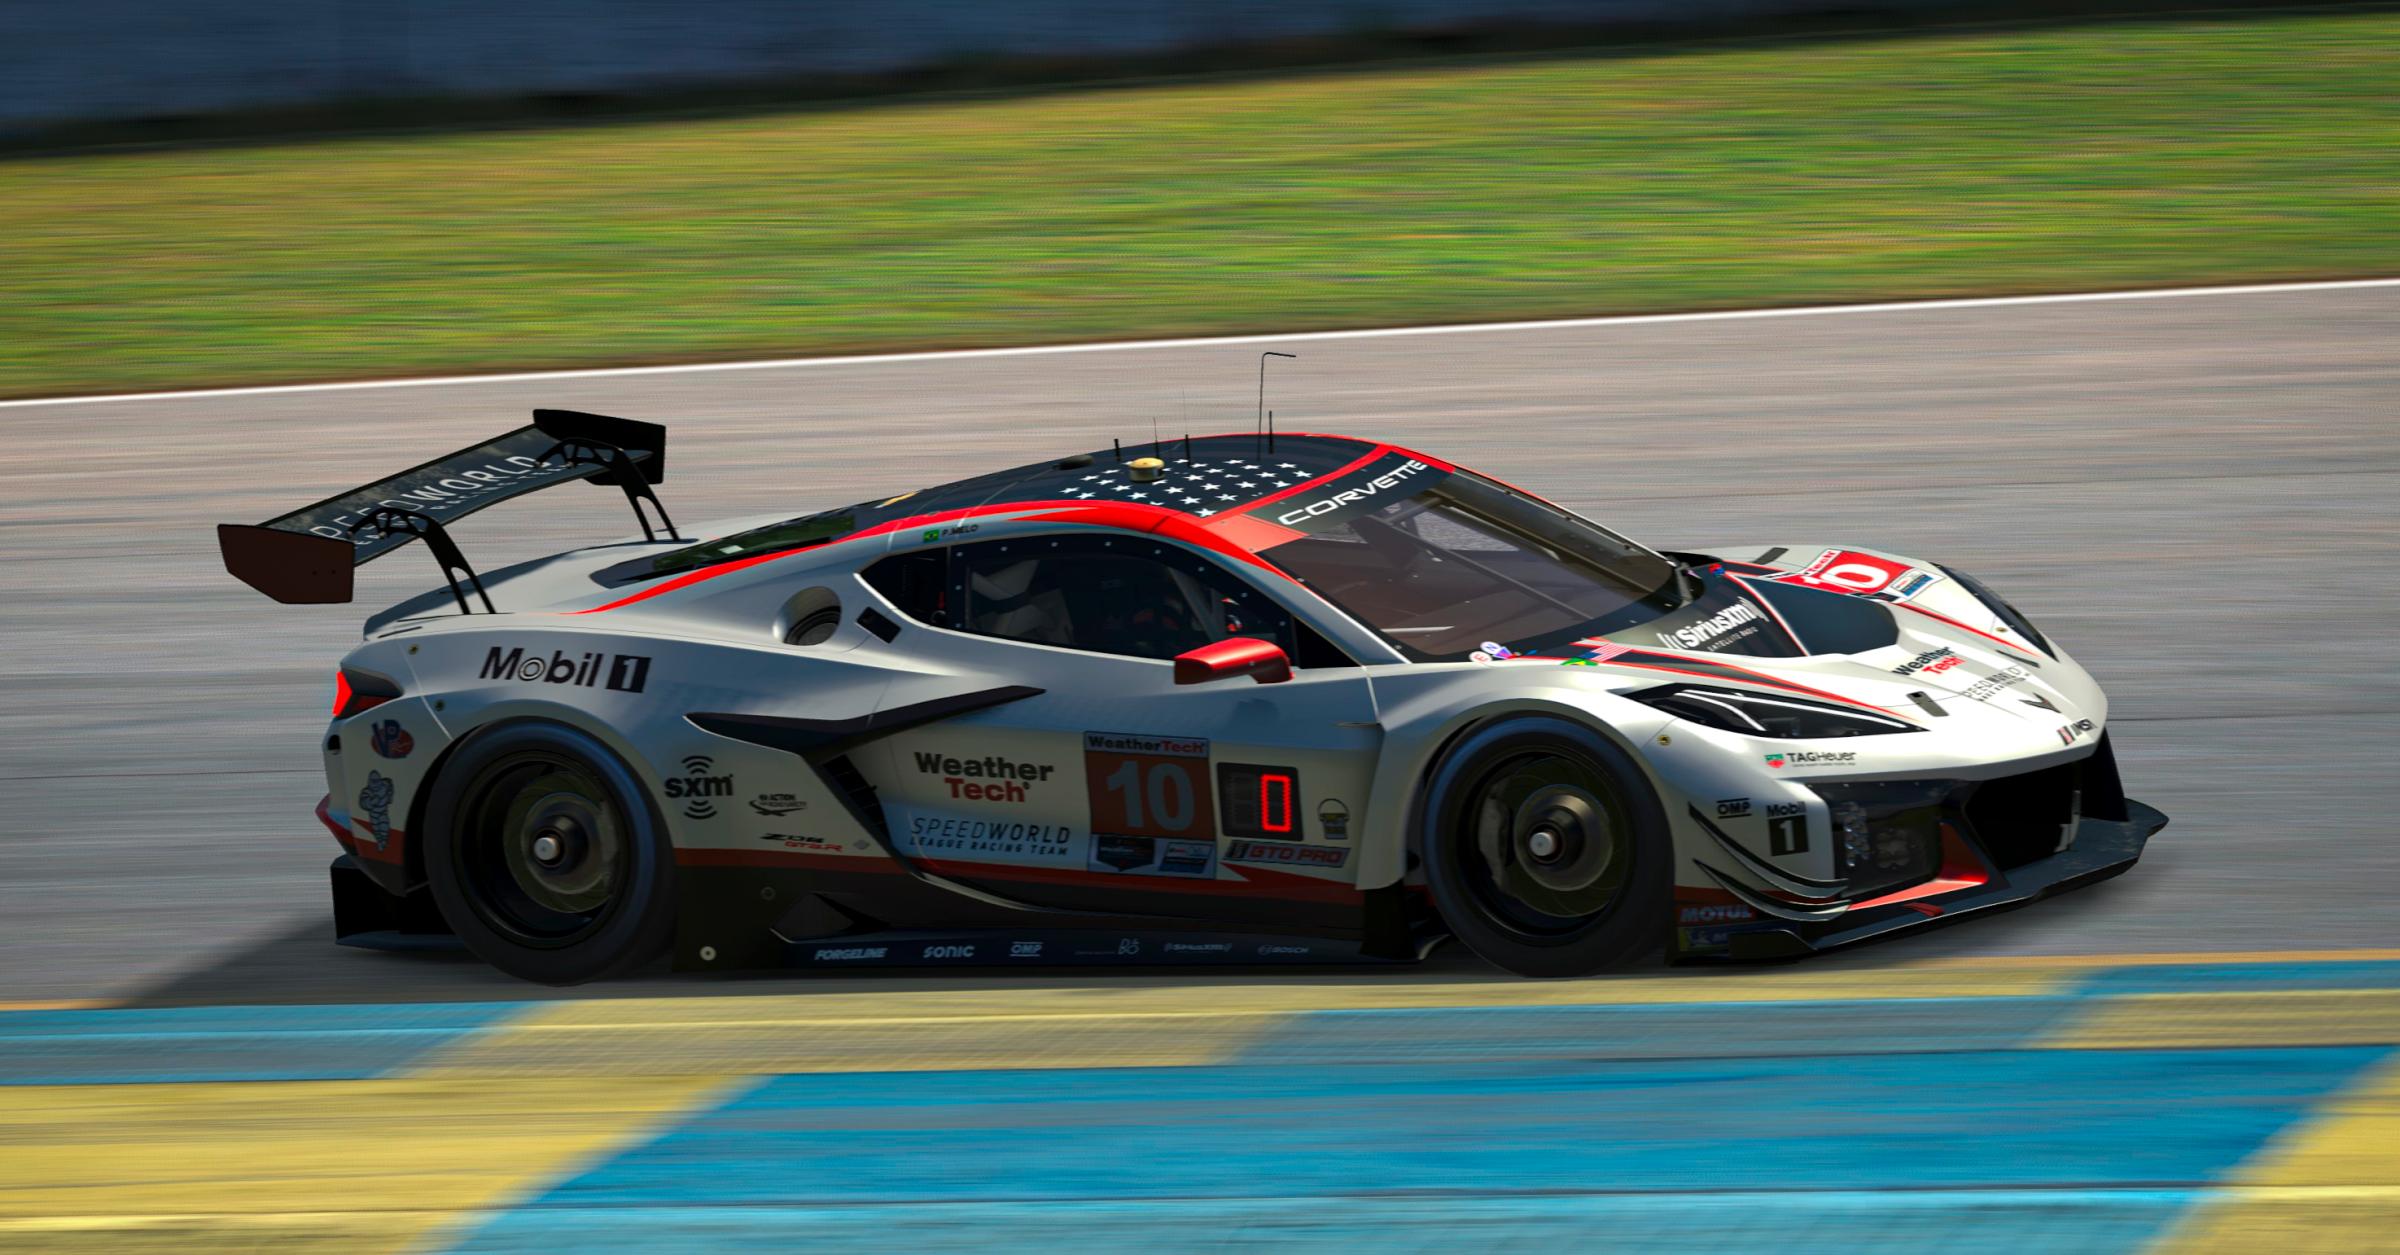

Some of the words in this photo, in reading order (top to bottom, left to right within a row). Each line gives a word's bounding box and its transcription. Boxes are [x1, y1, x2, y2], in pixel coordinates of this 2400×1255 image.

[1278, 459, 1428, 525] CORVETTE
[479, 646, 604, 687] Mobil
[1891, 646, 1955, 676] Weather
[1921, 656, 1967, 675] Tech
[1088, 734, 1206, 753] WeatherTech
[914, 751, 1054, 781] Weather
[664, 775, 733, 798] sxm
[944, 777, 1026, 802] Tech
[1107, 760, 1195, 831] 10
[1717, 801, 1750, 815] OMP
[1766, 801, 1807, 817] Mobil
[911, 817, 1071, 844] SPEEDWORLD
[909, 836, 964, 850] LEAGUE
[971, 840, 1023, 853] RACING
[1029, 844, 1069, 856] TEAM
[1680, 905, 1752, 922] MOTUL
[814, 947, 888, 961] FORGELINE
[1010, 943, 1042, 954] OMP
